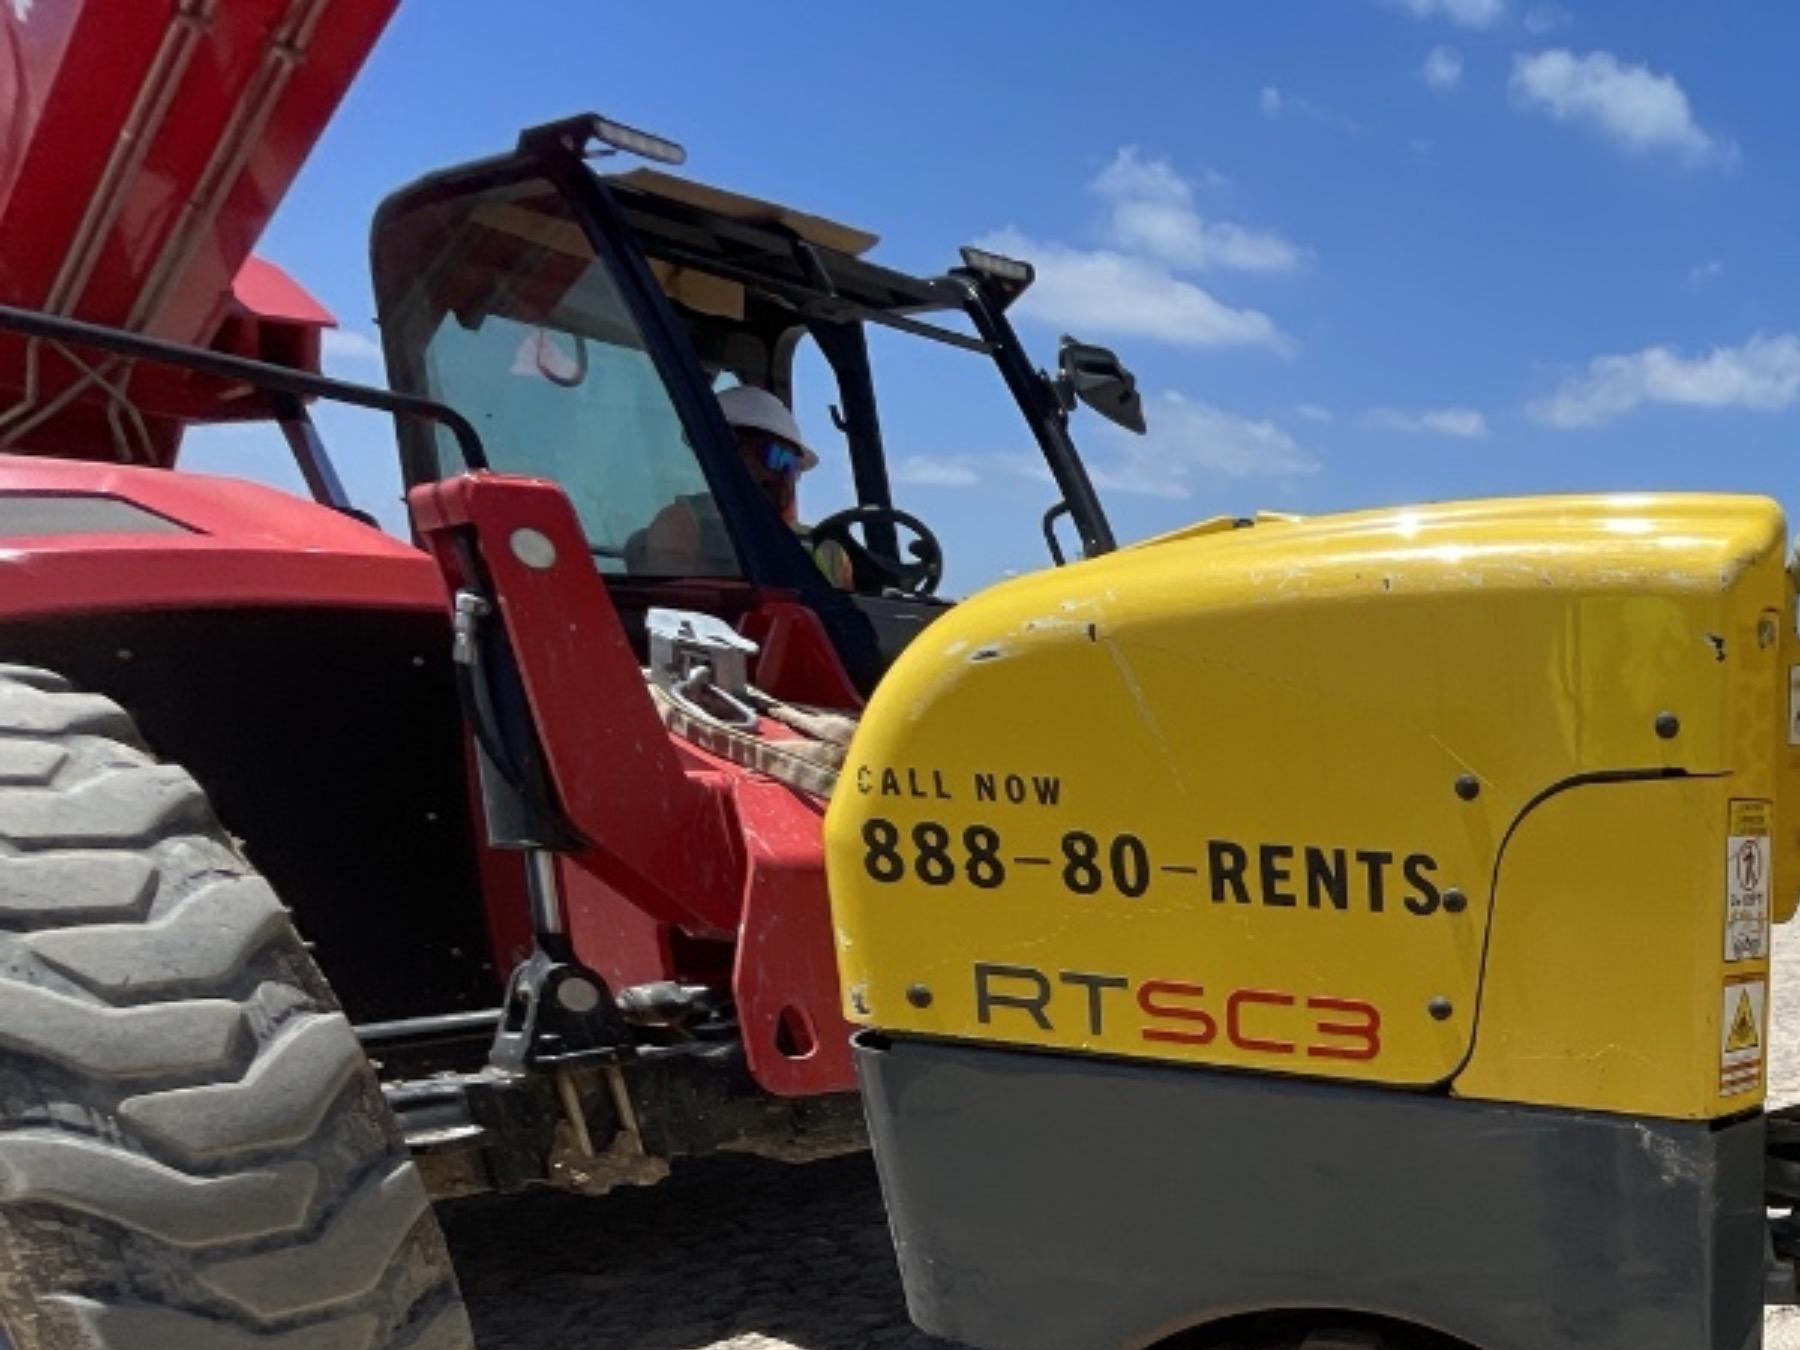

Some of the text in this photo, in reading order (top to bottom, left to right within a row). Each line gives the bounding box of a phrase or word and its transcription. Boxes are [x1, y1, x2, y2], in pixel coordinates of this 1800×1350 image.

[856, 766, 1061, 806] CALL NOW
[973, 962, 1382, 1062] RTSC3
